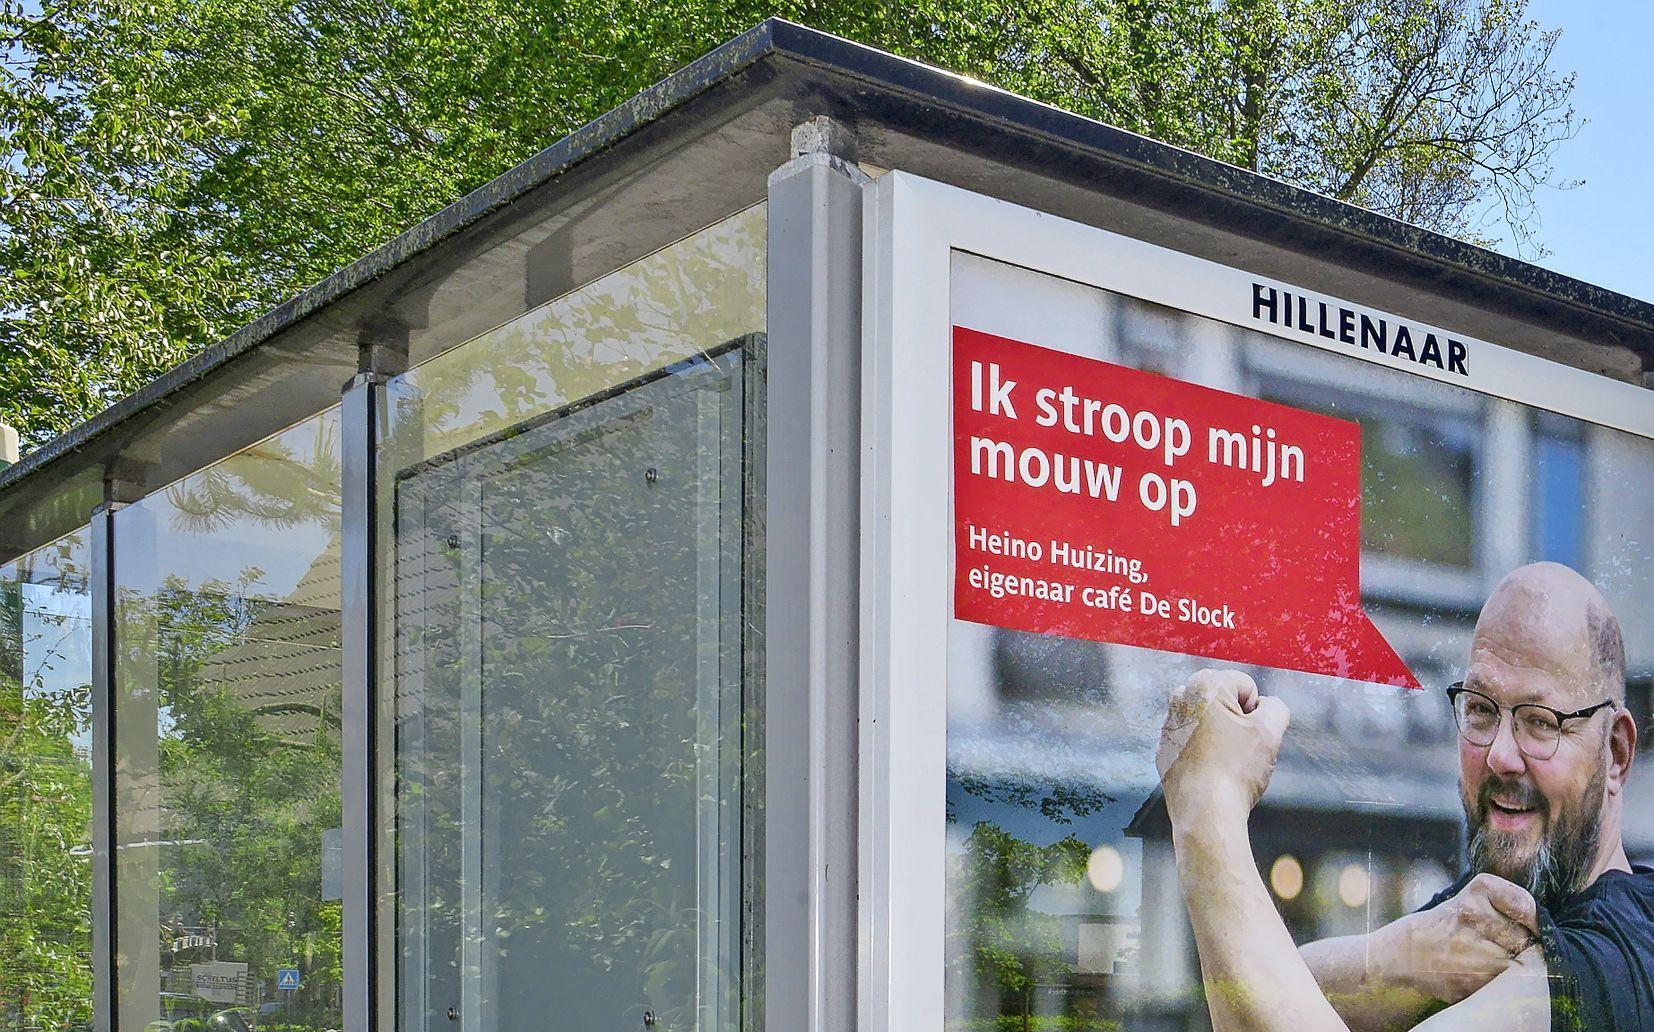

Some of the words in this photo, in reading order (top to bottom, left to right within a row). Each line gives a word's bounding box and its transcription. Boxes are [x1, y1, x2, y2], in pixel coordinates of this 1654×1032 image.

[1251, 281, 1470, 377] HILLENAAR
[970, 360, 1018, 420] Ik
[1034, 385, 1192, 466] stroop
[1207, 425, 1305, 488] mijn
[970, 435, 1123, 503] mouw
[1138, 472, 1198, 527] op
[968, 525, 1043, 562] Heino
[1050, 541, 1149, 584] Huizing,
[968, 565, 1075, 603] eigenaar
[1081, 585, 1133, 613] café
[1139, 591, 1172, 619] De
[1177, 598, 1236, 630] Slock
